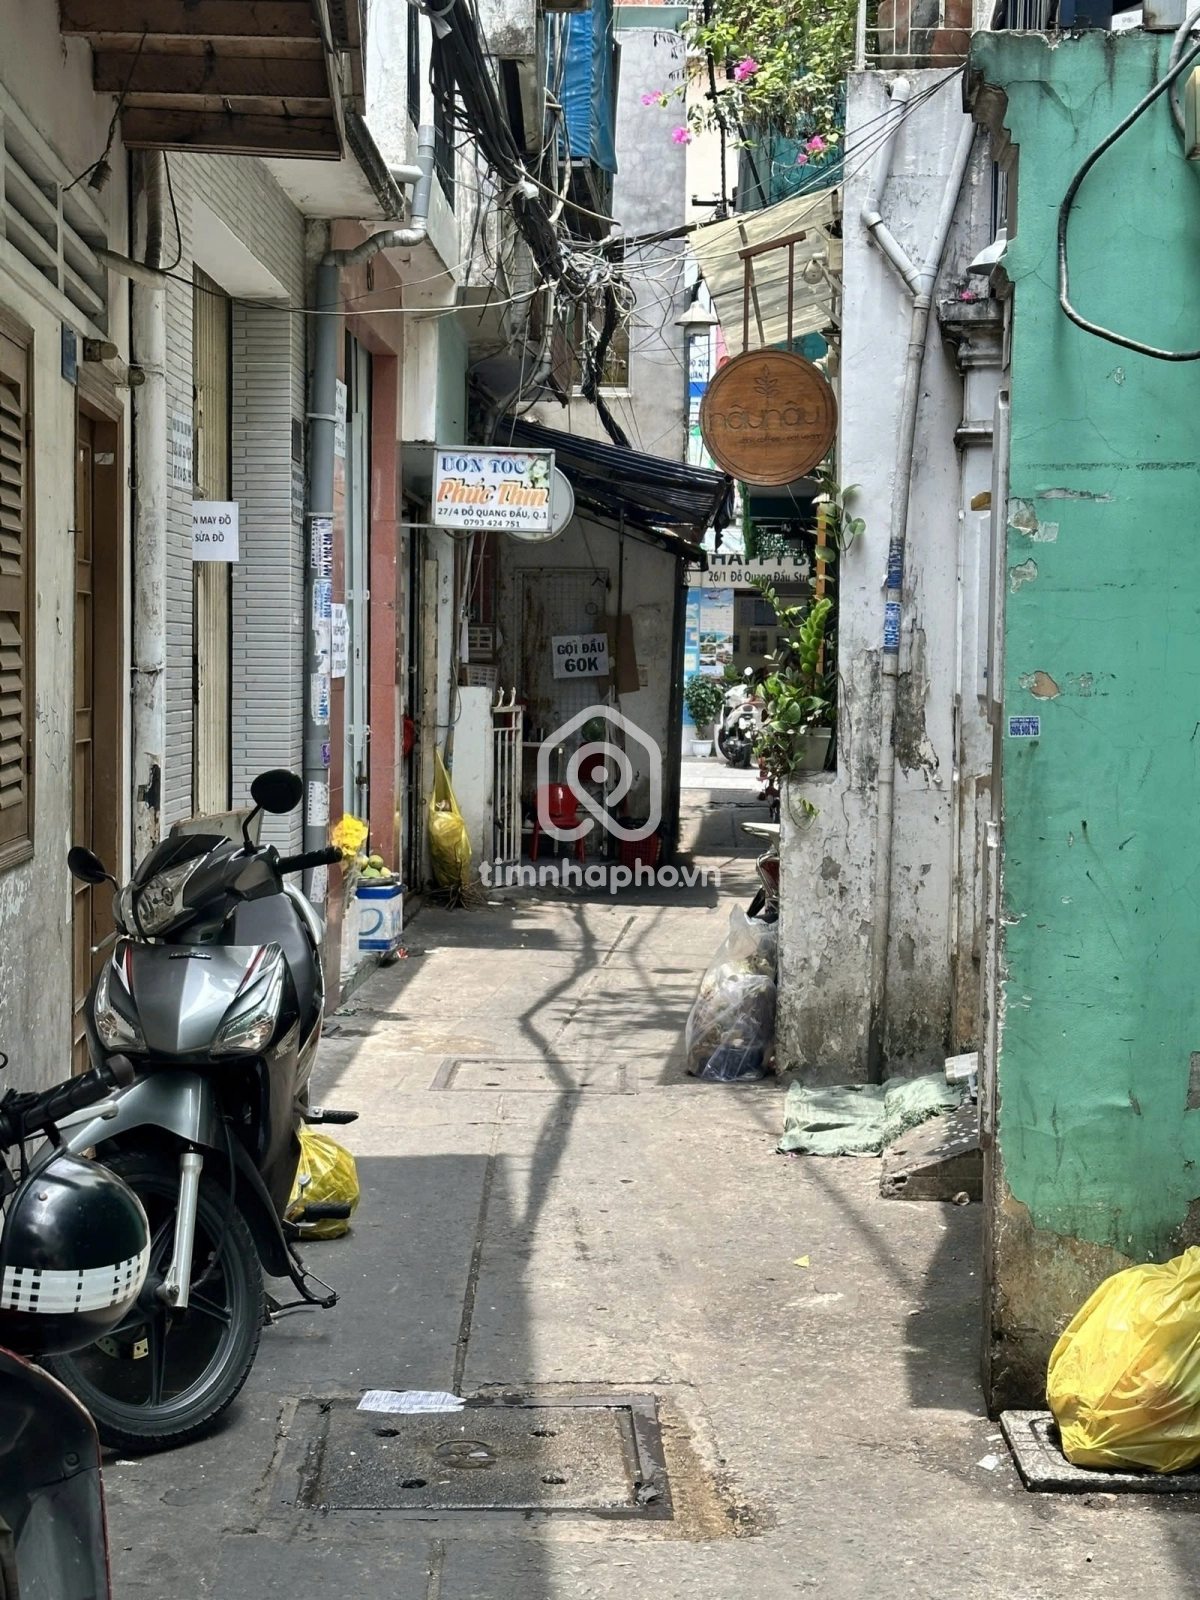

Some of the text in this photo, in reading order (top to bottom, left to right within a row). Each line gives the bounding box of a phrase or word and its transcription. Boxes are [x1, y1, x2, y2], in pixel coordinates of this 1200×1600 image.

[437, 478, 495, 505] Phúc
[438, 507, 459, 516] 27/4
[476, 508, 507, 518] QUANG
[200, 516, 217, 525] MAY
[219, 513, 232, 525] ĐỒ
[463, 518, 520, 528] 0793 424 751
[194, 530, 225, 542] SỬA ĐỒ
[708, 571, 726, 582] 26/1
[730, 568, 742, 582] Đỗ
[564, 656, 599, 673] 60K
